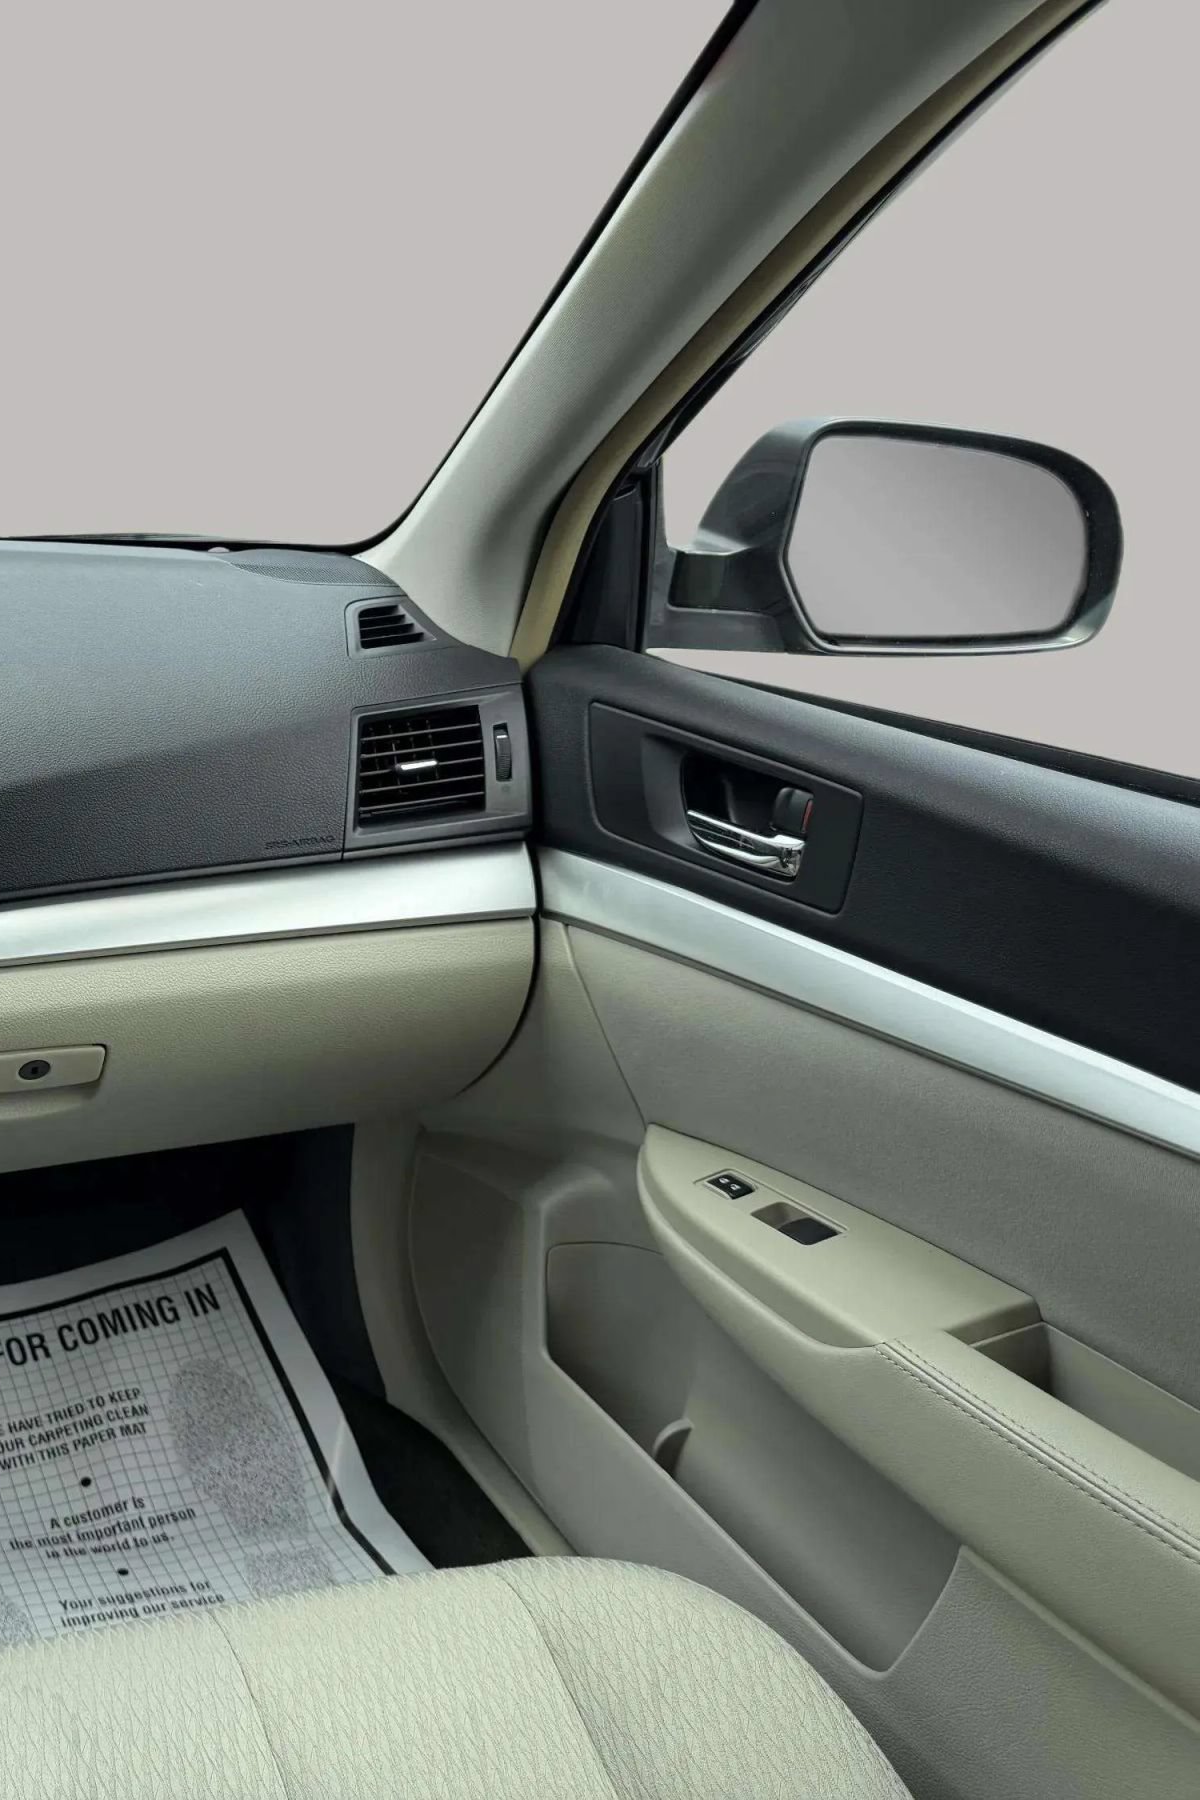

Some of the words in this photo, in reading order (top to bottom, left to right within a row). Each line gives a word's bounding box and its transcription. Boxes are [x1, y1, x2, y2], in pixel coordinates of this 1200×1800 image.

[57, 1296, 181, 1352] COMING
[184, 1283, 220, 1318] IN
[8, 1416, 43, 1434] HAVE
[46, 1404, 86, 1425] TRIED
[88, 1395, 106, 1411] TO
[108, 1387, 142, 1404] KEEP
[28, 1414, 104, 1446] CARPETING
[106, 1404, 150, 1423] CLEAN
[38, 1445, 70, 1462] THIS
[73, 1430, 118, 1451] PAPER
[120, 1422, 148, 1438] MAT
[10, 1538, 33, 1551] the
[37, 1532, 73, 1547] most
[76, 1514, 148, 1544] important
[149, 1507, 198, 1530] person
[50, 1518, 62, 1530] A
[64, 1500, 128, 1525] customer
[132, 1496, 146, 1510] is
[64, 1545, 88, 1558] the
[92, 1538, 132, 1554] world
[134, 1536, 150, 1548] to
[151, 1530, 176, 1546] us.
[58, 1598, 94, 1612] Your
[98, 1585, 188, 1607] suggestions
[190, 1578, 212, 1591] for
[60, 1606, 140, 1628] improving
[142, 1604, 168, 1616] our
[171, 1593, 226, 1610] service
